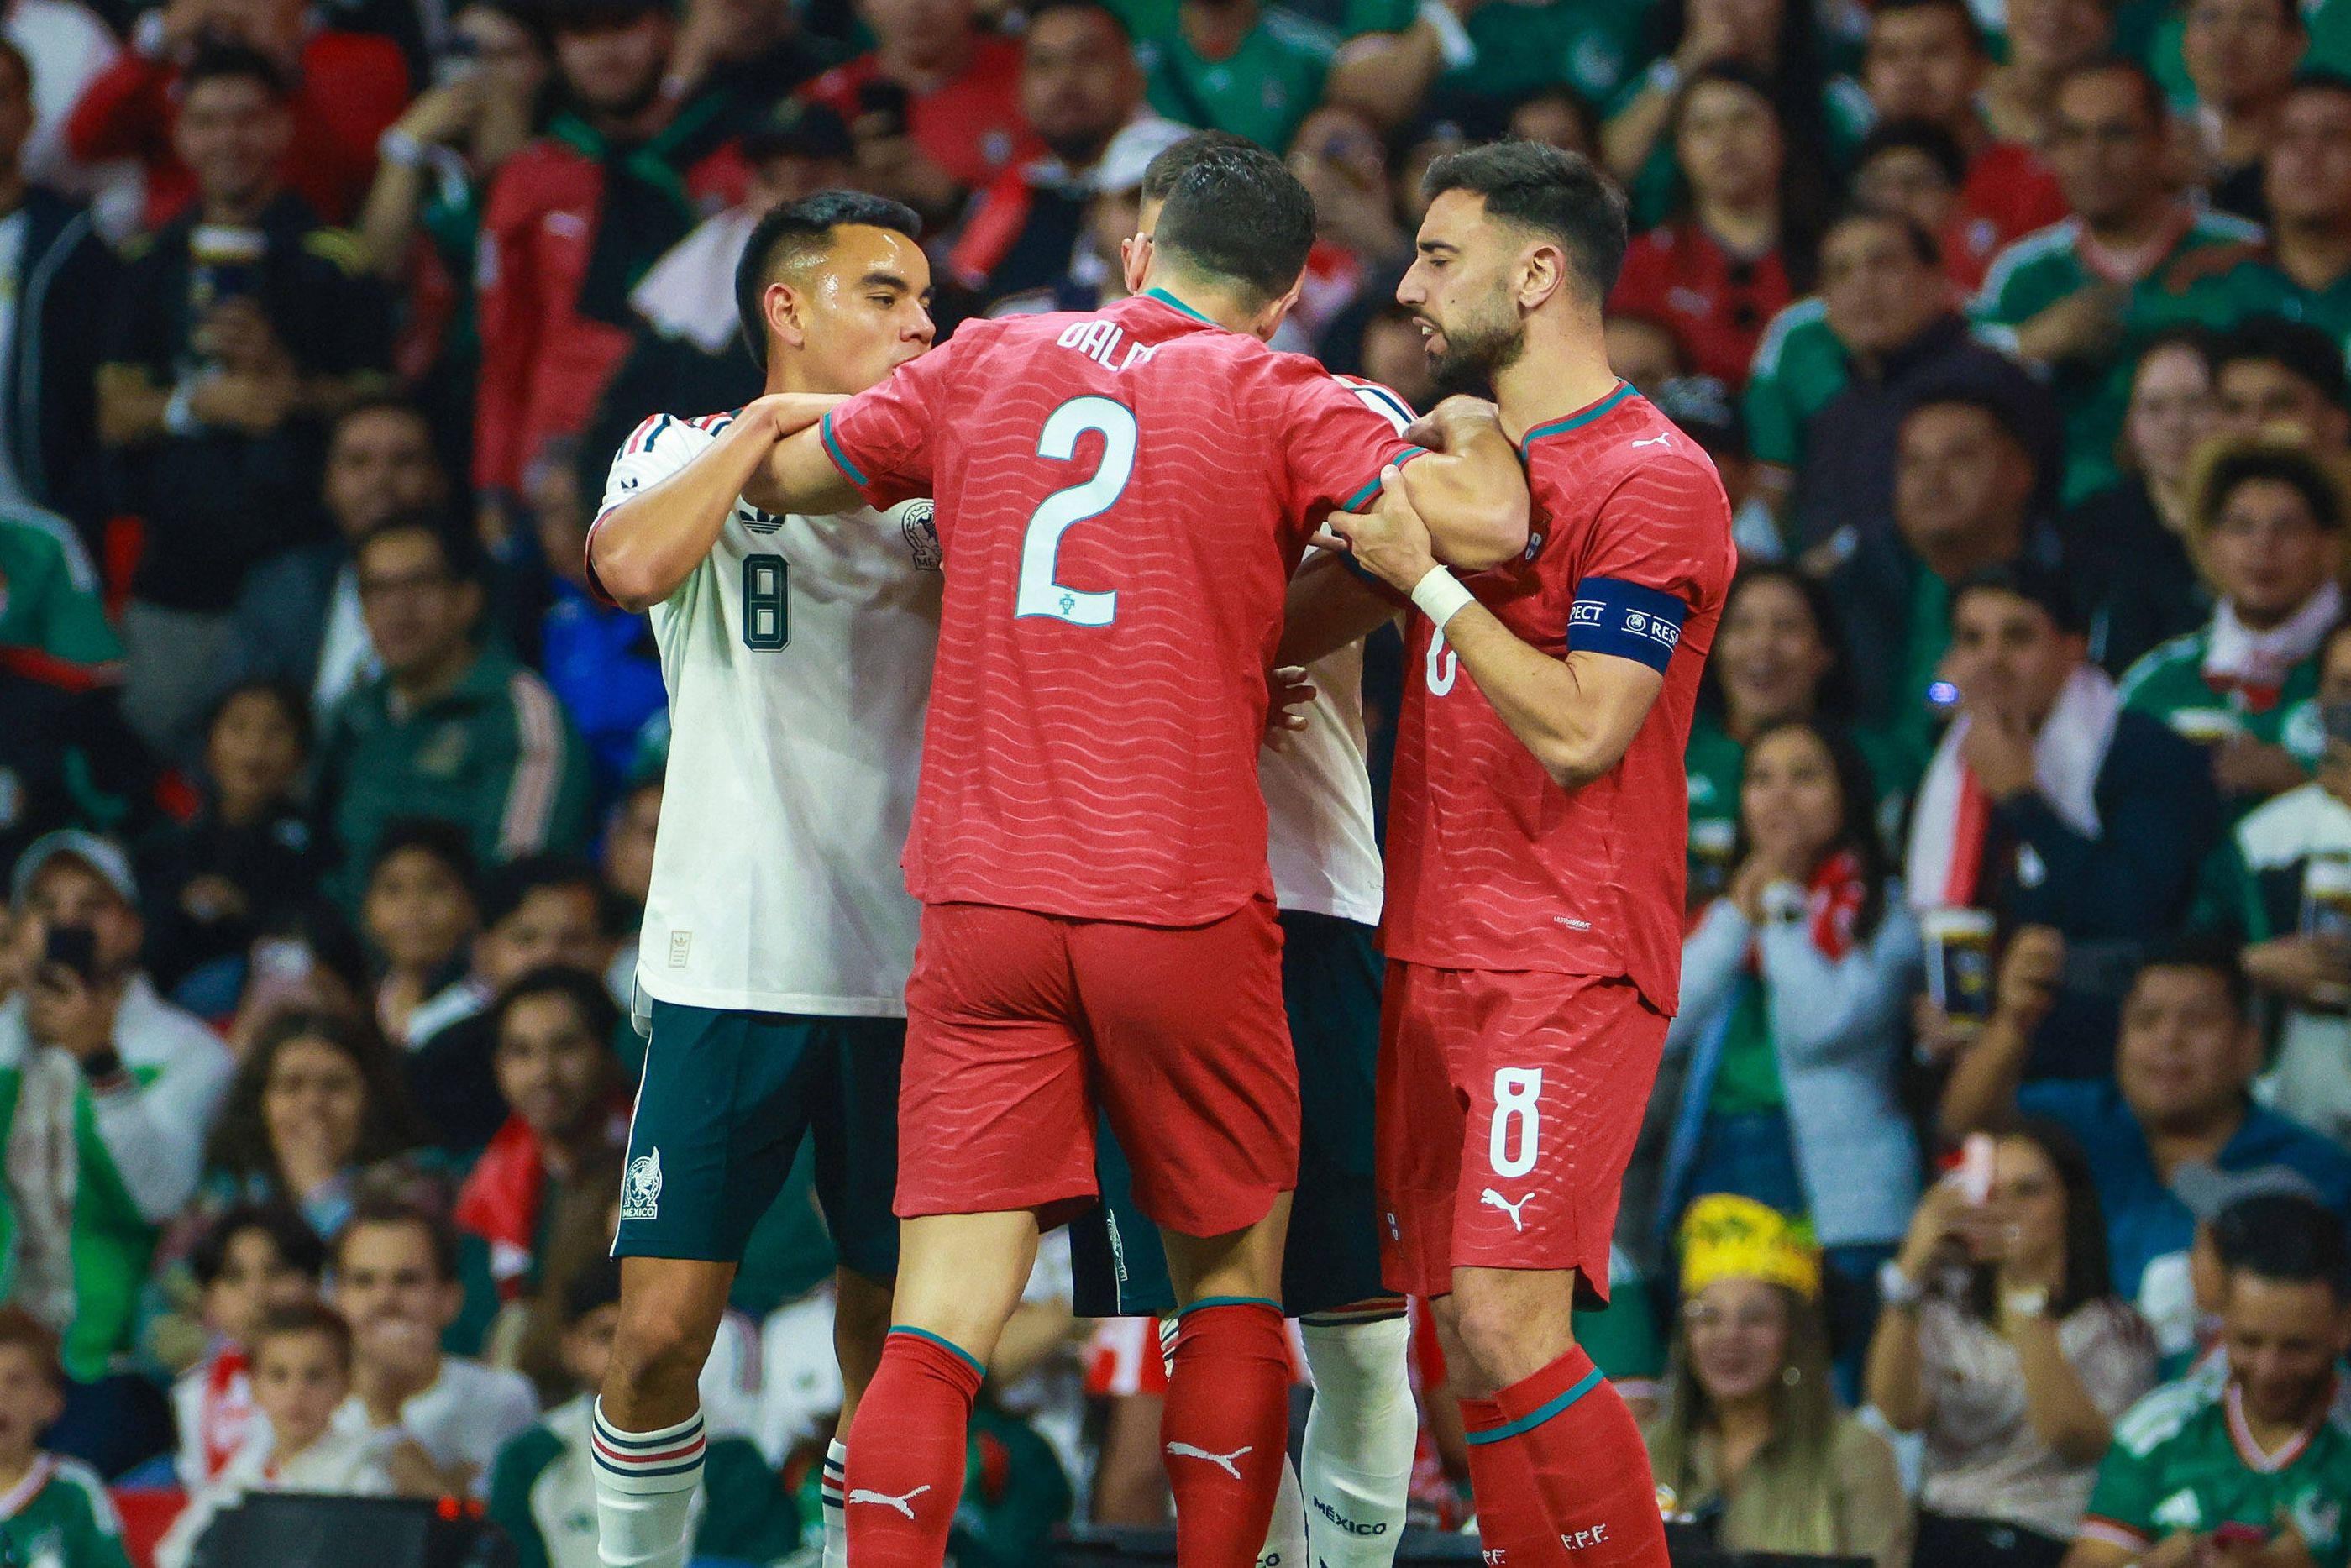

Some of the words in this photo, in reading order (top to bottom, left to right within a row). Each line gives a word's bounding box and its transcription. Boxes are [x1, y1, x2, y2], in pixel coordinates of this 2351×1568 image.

[1015, 394, 1137, 627] 2
[743, 553, 791, 653] 8
[1489, 1067, 1542, 1177] 8
[623, 1206, 653, 1218] MÉXICO
[1313, 1495, 1387, 1535] MÉXICO
[1561, 1523, 1609, 1550] F.P.F.
